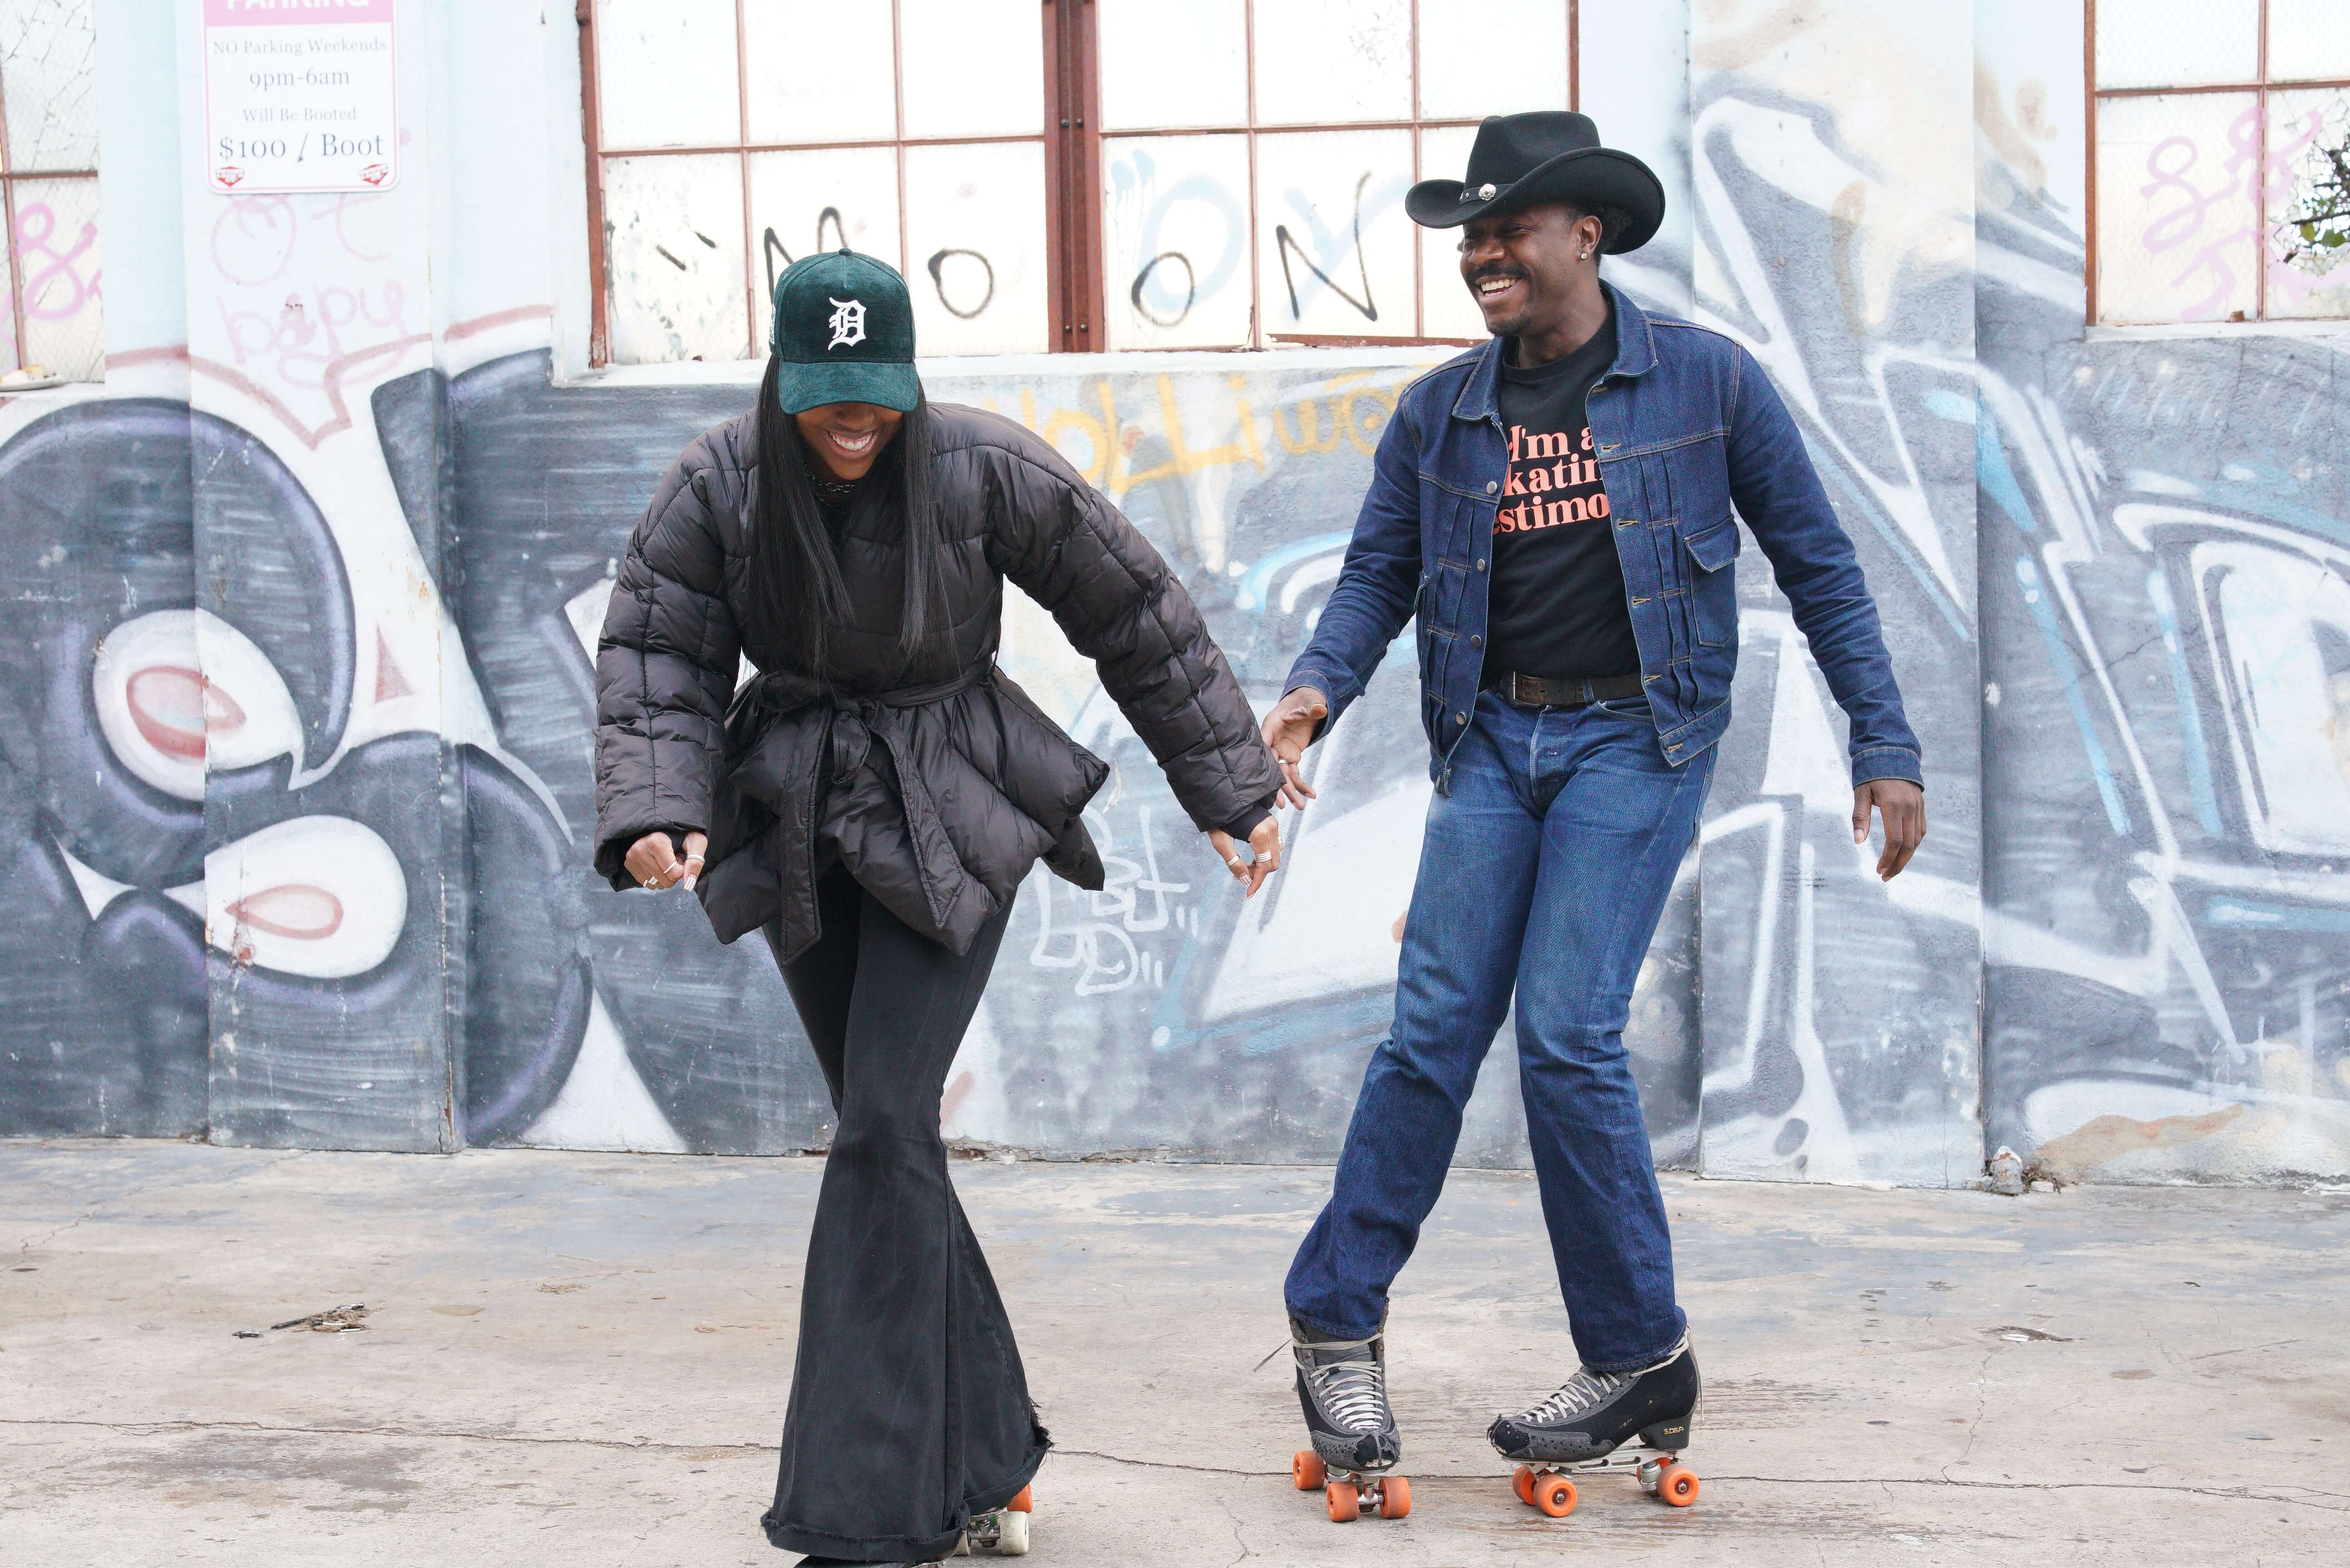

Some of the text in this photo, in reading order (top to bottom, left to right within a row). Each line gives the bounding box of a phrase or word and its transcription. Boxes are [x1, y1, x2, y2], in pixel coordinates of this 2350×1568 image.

[214, 36, 387, 56] NO Parking Weekends
[250, 67, 350, 91] 9pm-6am
[242, 106, 357, 122] Will Be Booted
[219, 133, 384, 163] $100 / Boot
[828, 297, 867, 351] D
[1508, 425, 1571, 462] I'm
